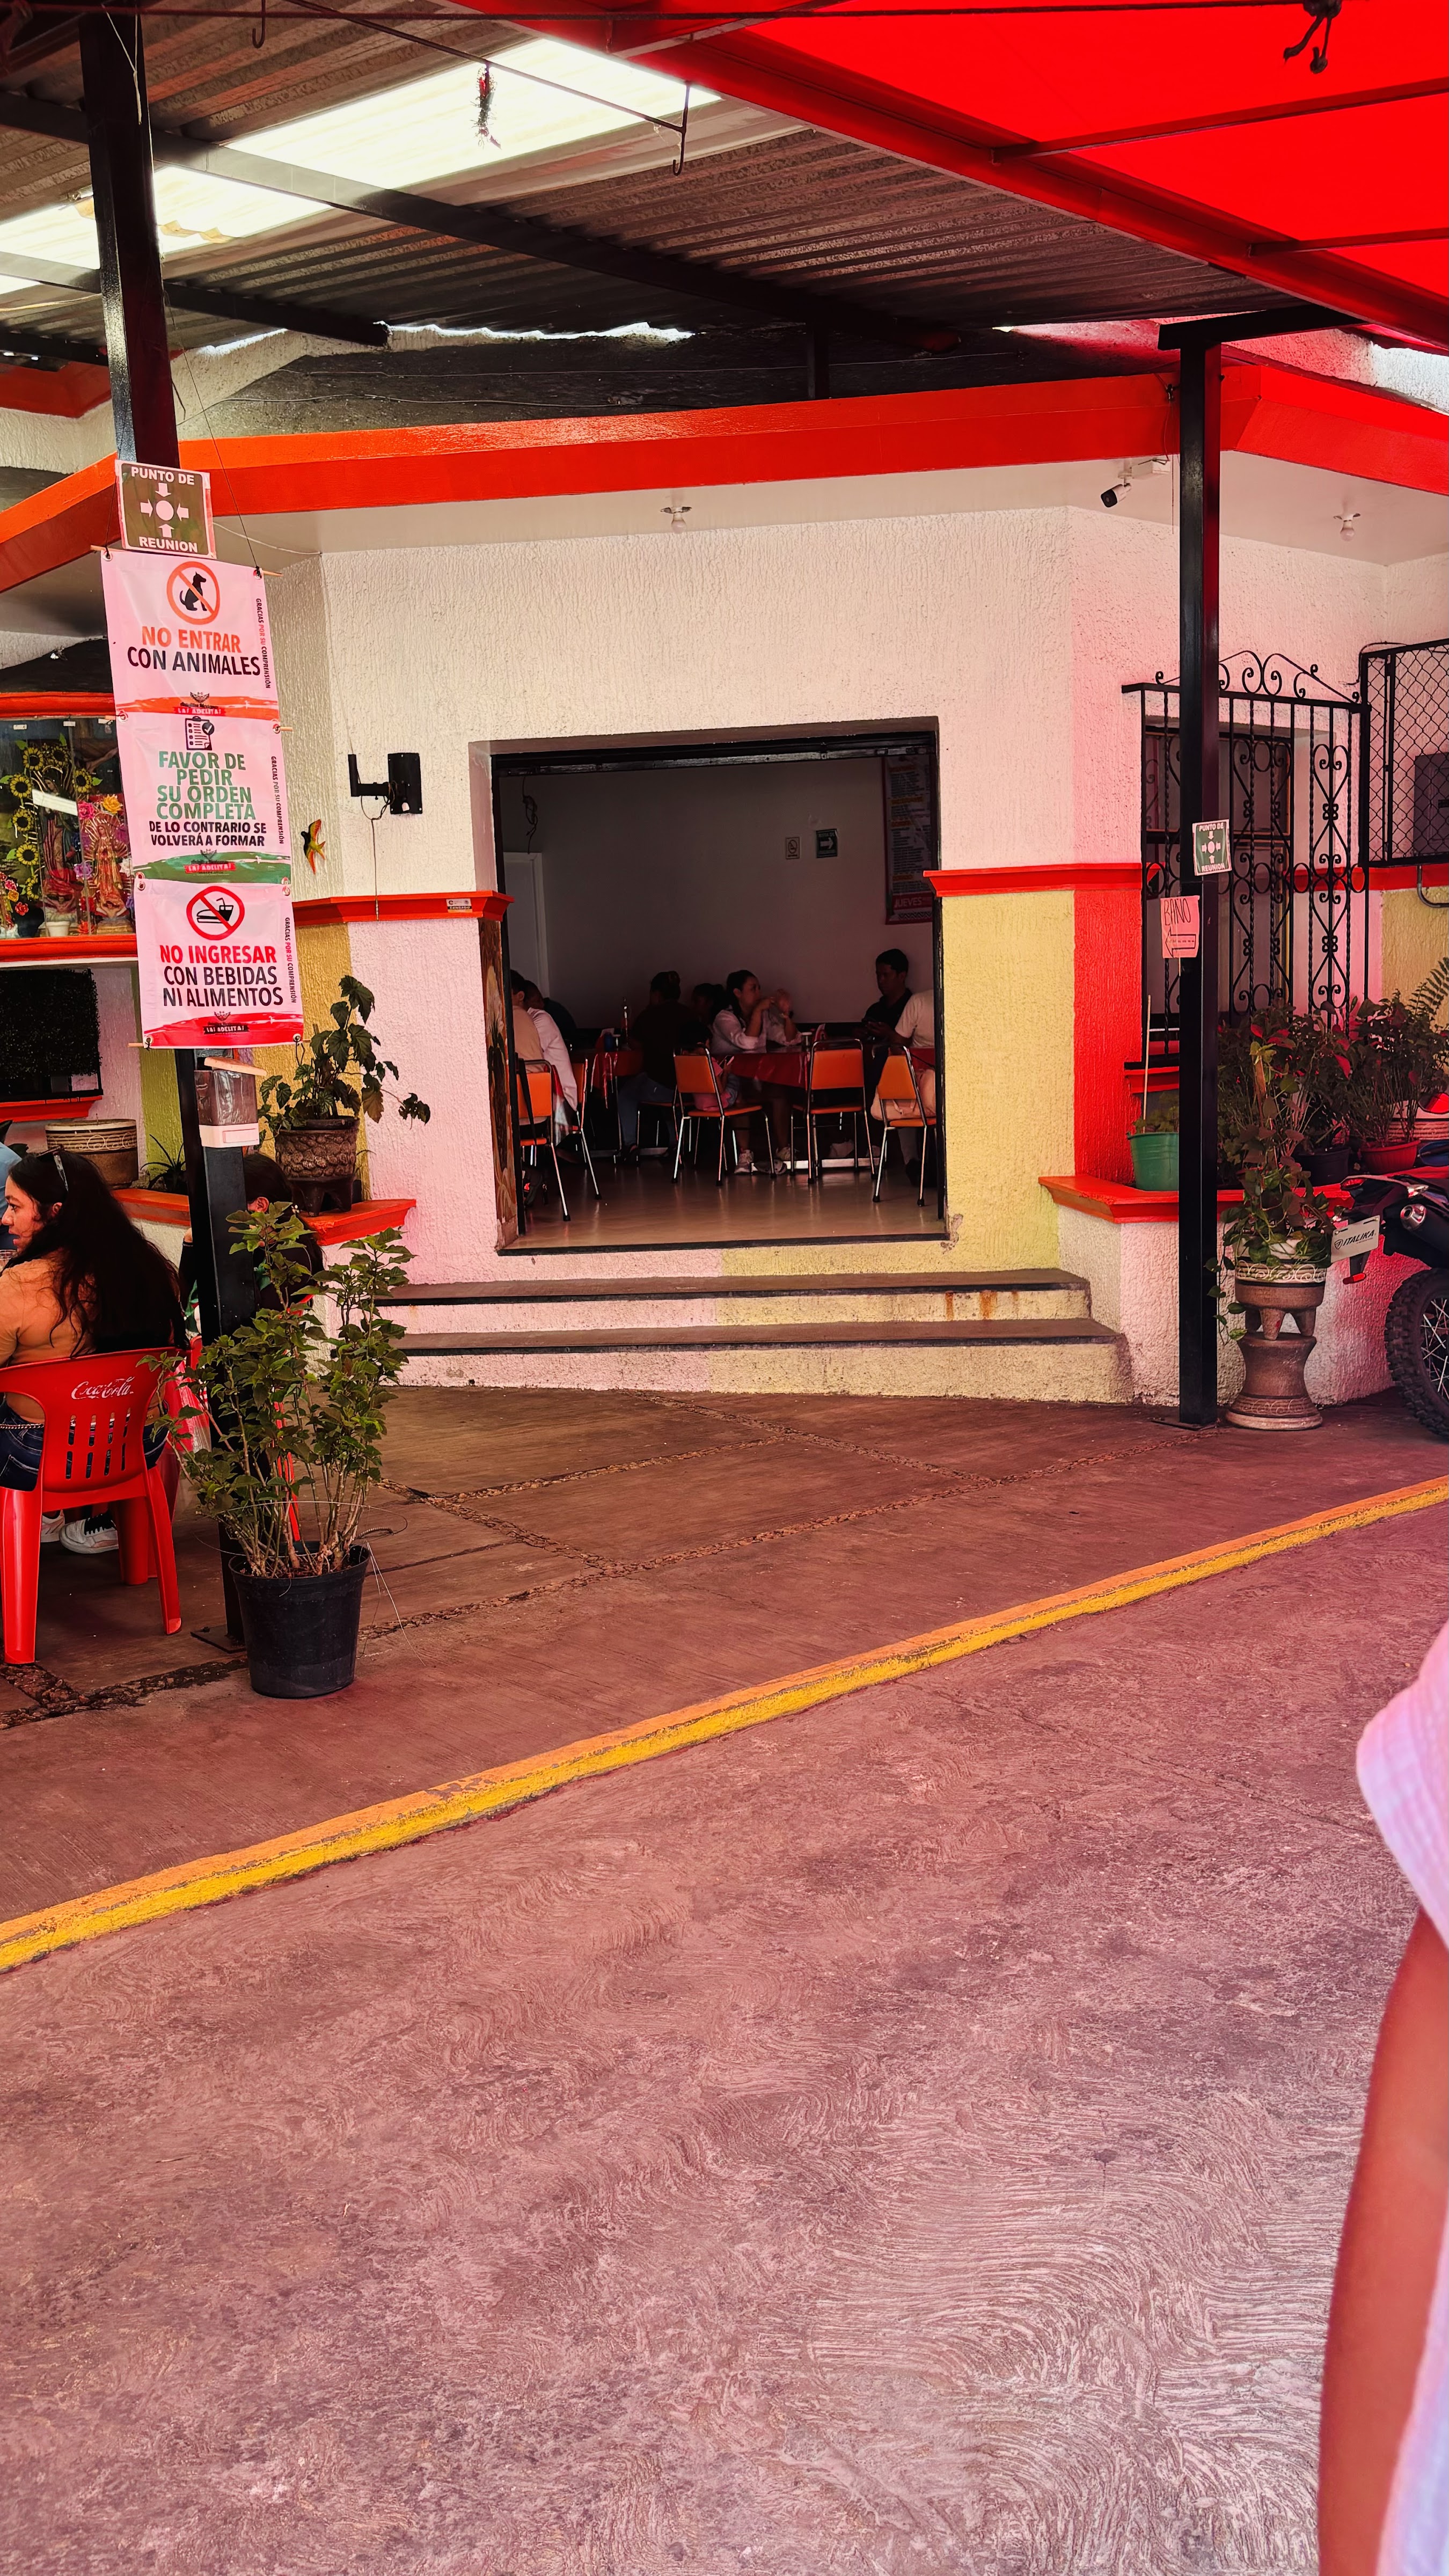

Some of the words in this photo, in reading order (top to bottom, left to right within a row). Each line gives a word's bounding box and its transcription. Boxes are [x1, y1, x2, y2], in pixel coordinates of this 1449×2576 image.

[131, 466, 174, 482] PUNTO
[178, 473, 194, 485] DE
[139, 537, 198, 553] REUNION
[256, 598, 264, 623] GRACIAS
[260, 638, 266, 646] SU
[142, 626, 171, 647] NO
[179, 630, 241, 653] ENTRAR
[127, 647, 166, 670] CON
[172, 652, 260, 676] ANIMALES
[159, 751, 219, 769] FAVOR
[225, 753, 246, 770] DE
[177, 769, 232, 786] PEDIR
[157, 785, 180, 802] SU
[187, 786, 252, 803] ORDEN
[156, 803, 256, 820] COMPLETA
[149, 821, 162, 832] DE
[165, 821, 180, 833] LO
[184, 822, 251, 833] CONTRARIO
[253, 822, 267, 834] SE
[1199, 823, 1216, 832] PUNTO
[151, 832, 203, 846] VOLVERÁ
[205, 835, 213, 846] A
[216, 835, 265, 847] FORMAR
[1201, 862, 1225, 873] REUNION
[894, 897, 922, 908] JUEVES
[159, 945, 183, 963] NO
[188, 945, 277, 964] INGRESAR
[164, 966, 197, 985] CON
[204, 966, 277, 985] BEBIDAS
[163, 988, 182, 1006] NI
[187, 987, 284, 1007] ALIMENTOS
[1343, 1230, 1374, 1246] ITALIKA
